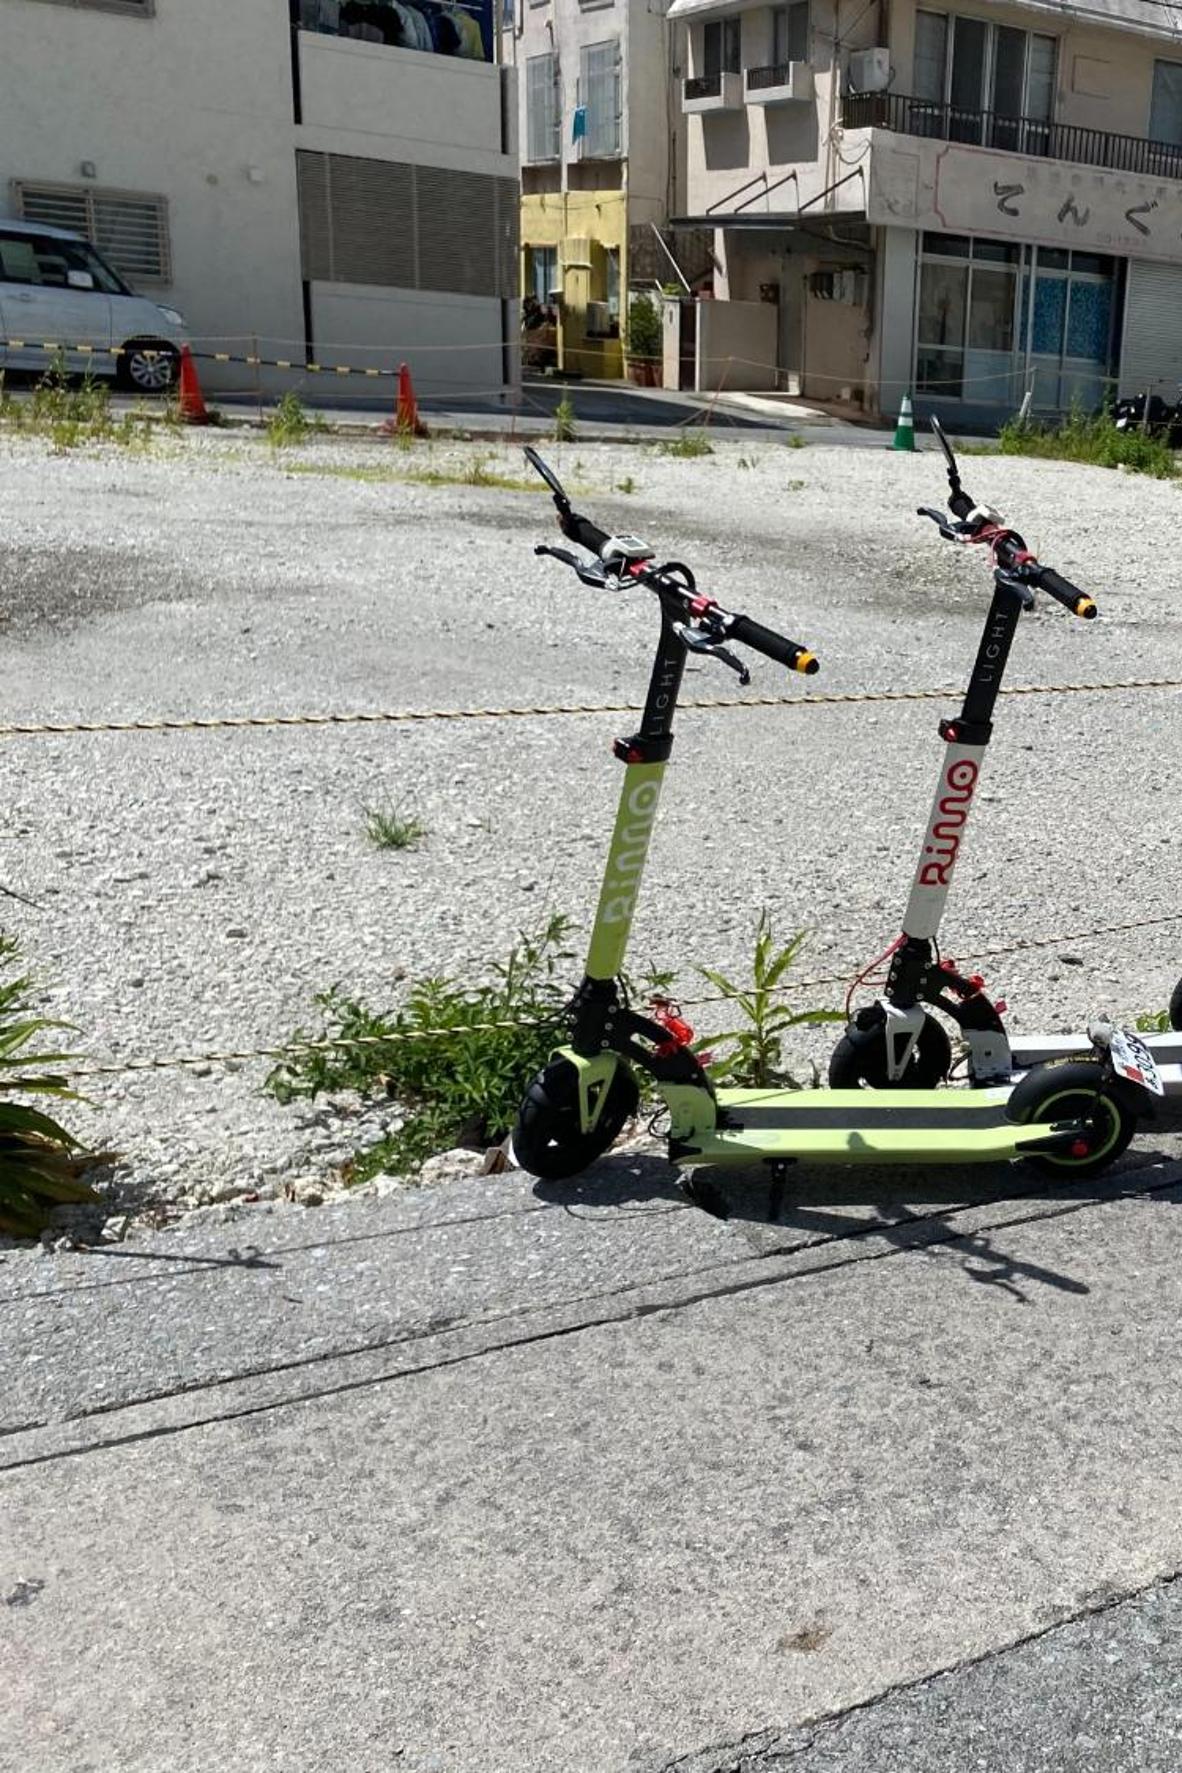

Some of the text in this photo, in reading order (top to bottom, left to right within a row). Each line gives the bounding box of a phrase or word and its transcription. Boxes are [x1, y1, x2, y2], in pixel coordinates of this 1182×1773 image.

[978, 613, 1008, 683] LIGHT
[649, 658, 678, 736] LIGHT
[920, 759, 979, 886] Rinno
